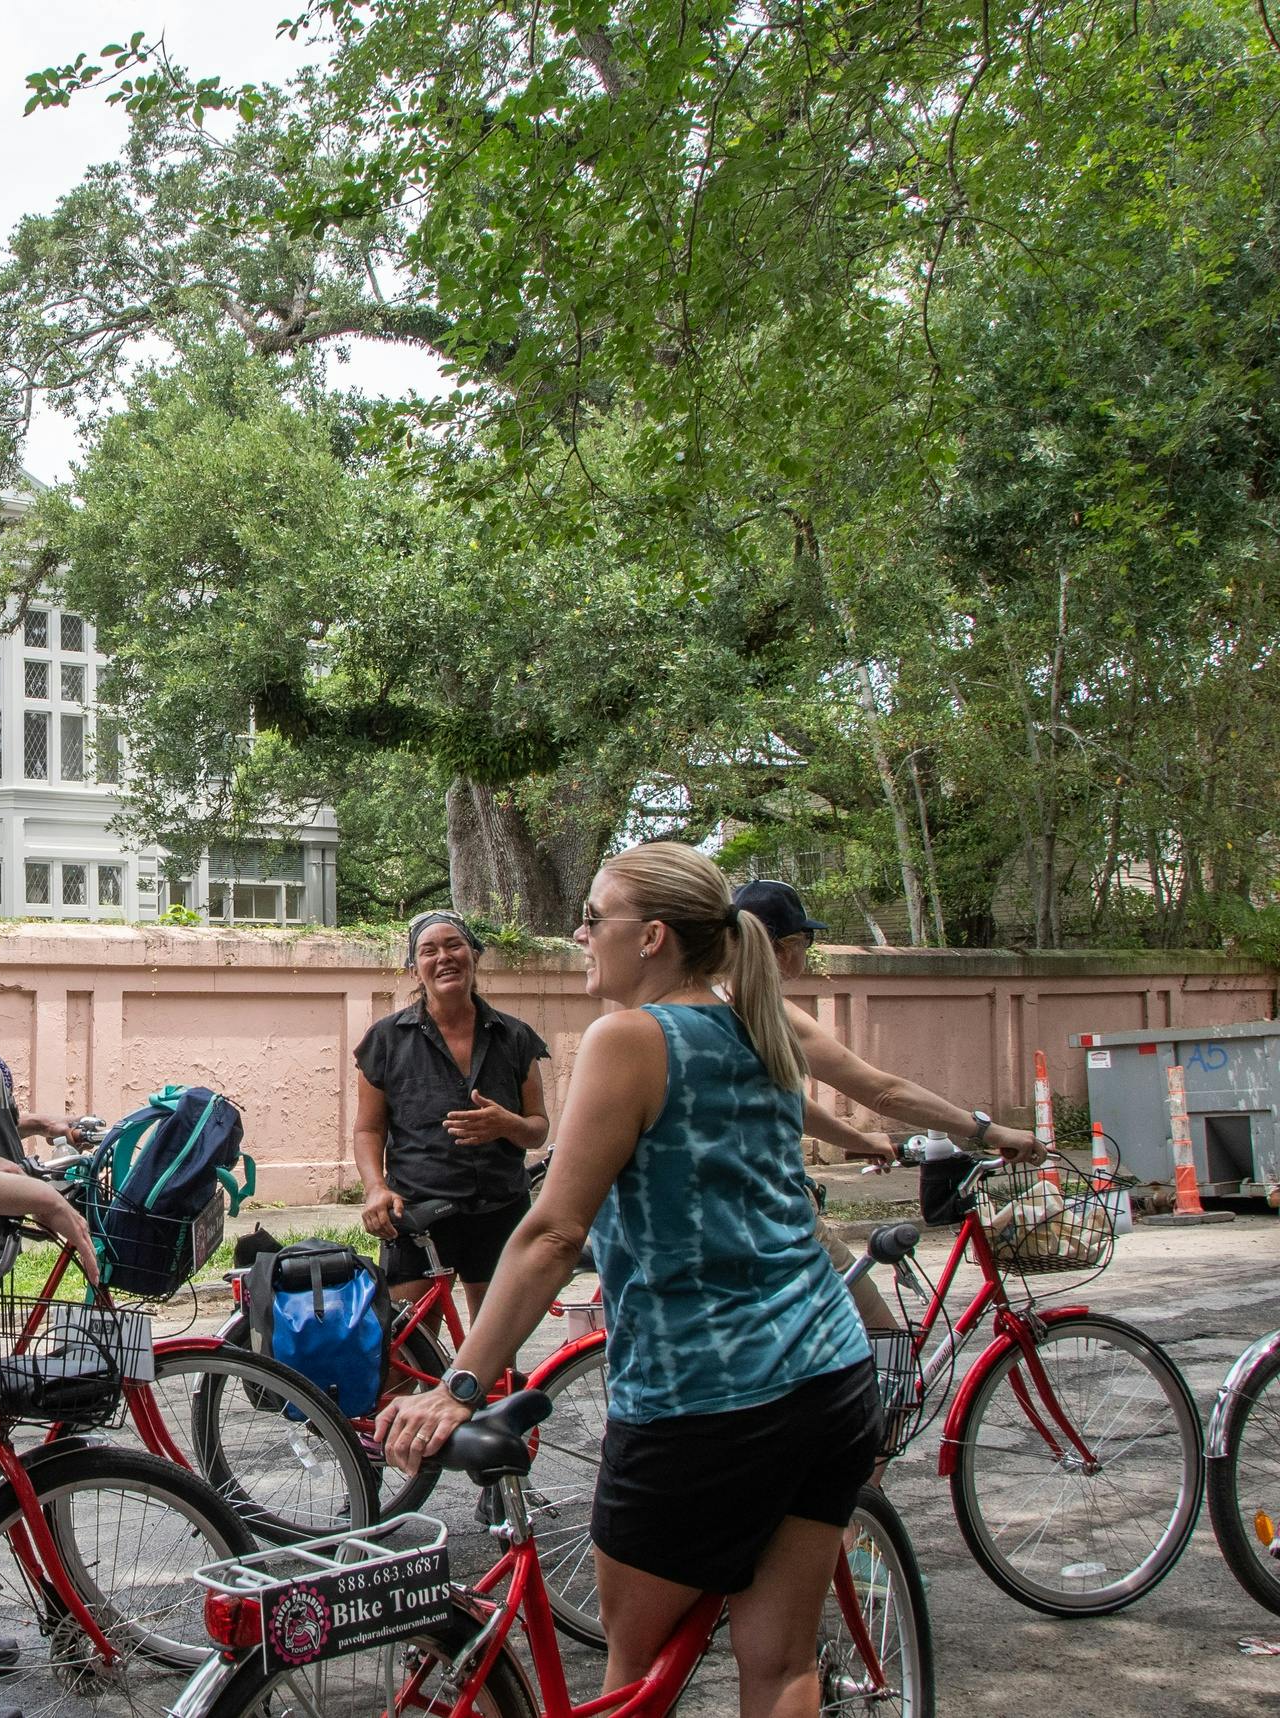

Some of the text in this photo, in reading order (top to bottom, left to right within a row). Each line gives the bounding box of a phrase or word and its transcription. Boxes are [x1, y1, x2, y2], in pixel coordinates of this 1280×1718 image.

[1187, 1041, 1228, 1073] A5
[338, 1554, 440, 1594] 888.683.8687
[275, 1593, 324, 1628] PAVED PARADISE
[331, 1582, 451, 1628] Bike Tours
[338, 1611, 448, 1649] pavedparadisetoursnola.com
[291, 1643, 312, 1654] TOURS
